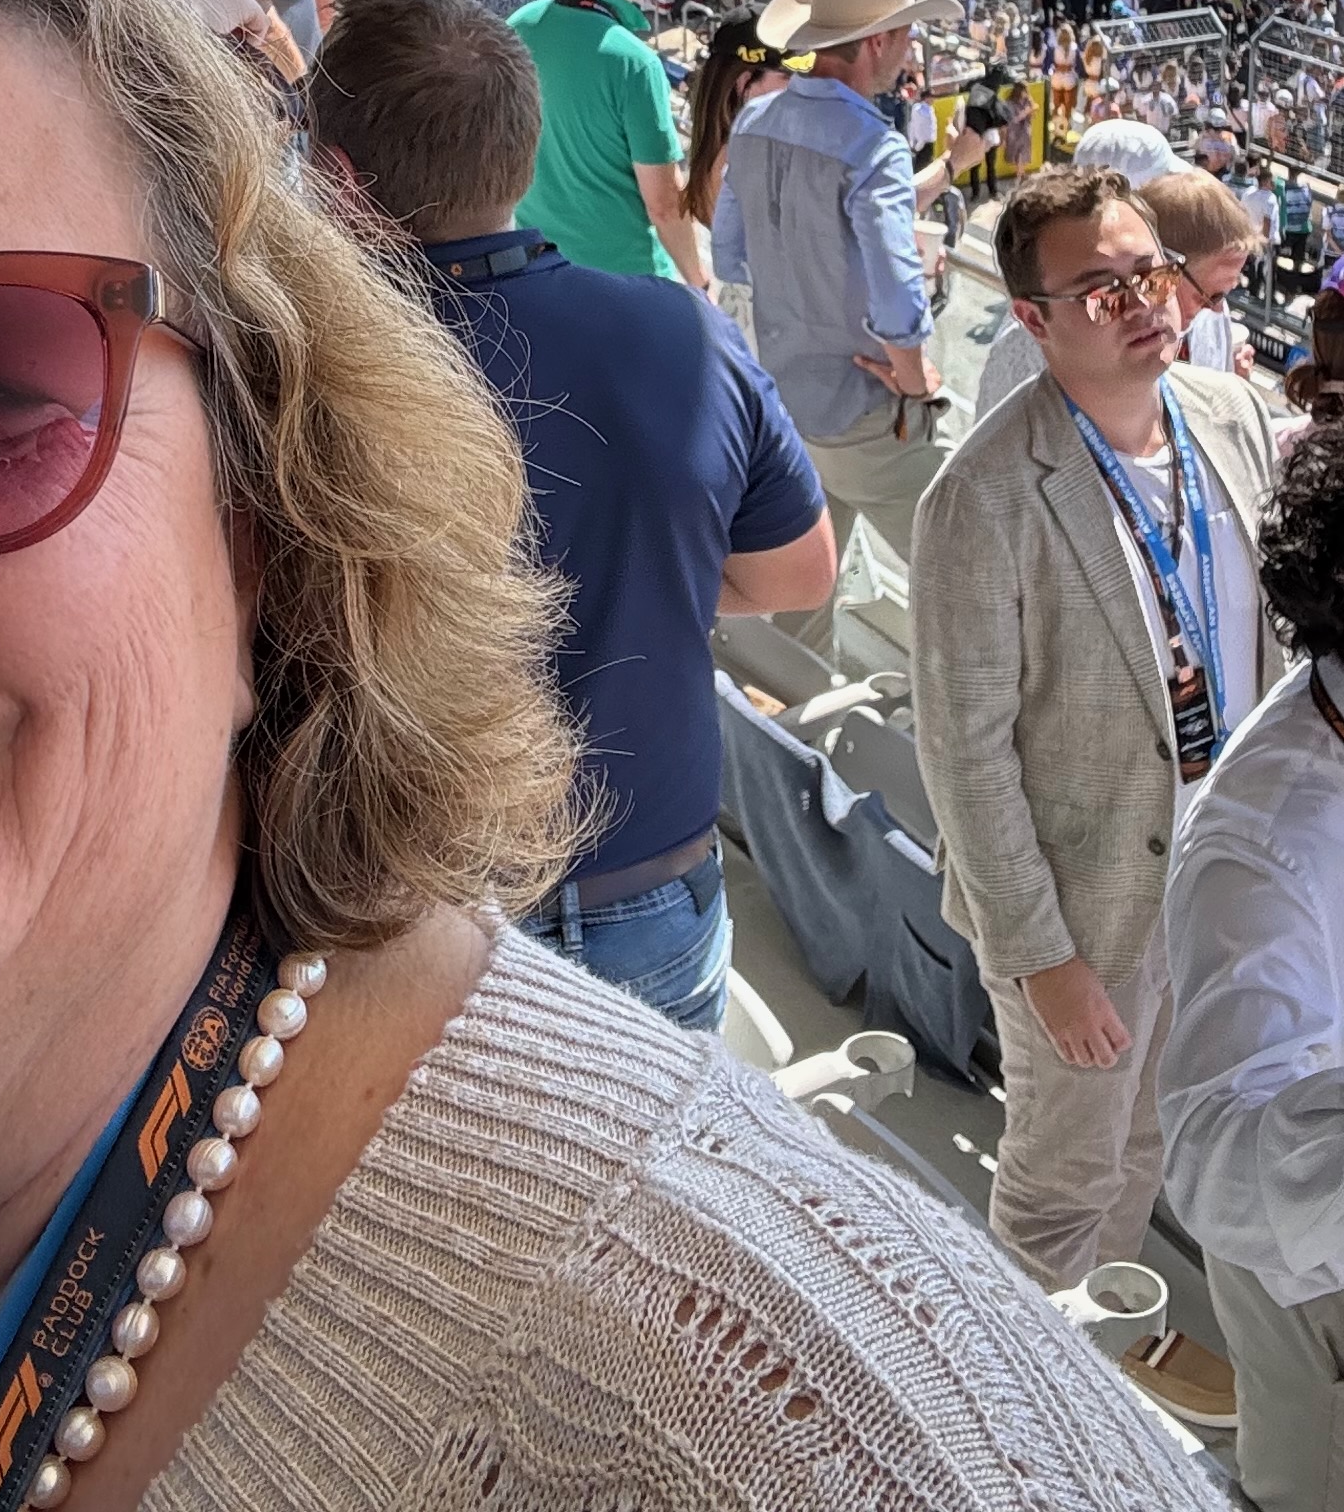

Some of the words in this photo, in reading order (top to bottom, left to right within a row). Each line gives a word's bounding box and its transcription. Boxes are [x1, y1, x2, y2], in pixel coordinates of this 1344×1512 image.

[208, 973, 231, 1002] FIA
[224, 962, 253, 1009] World
[32, 1227, 105, 1350] PADDOCK
[51, 1290, 94, 1357] CLUB
